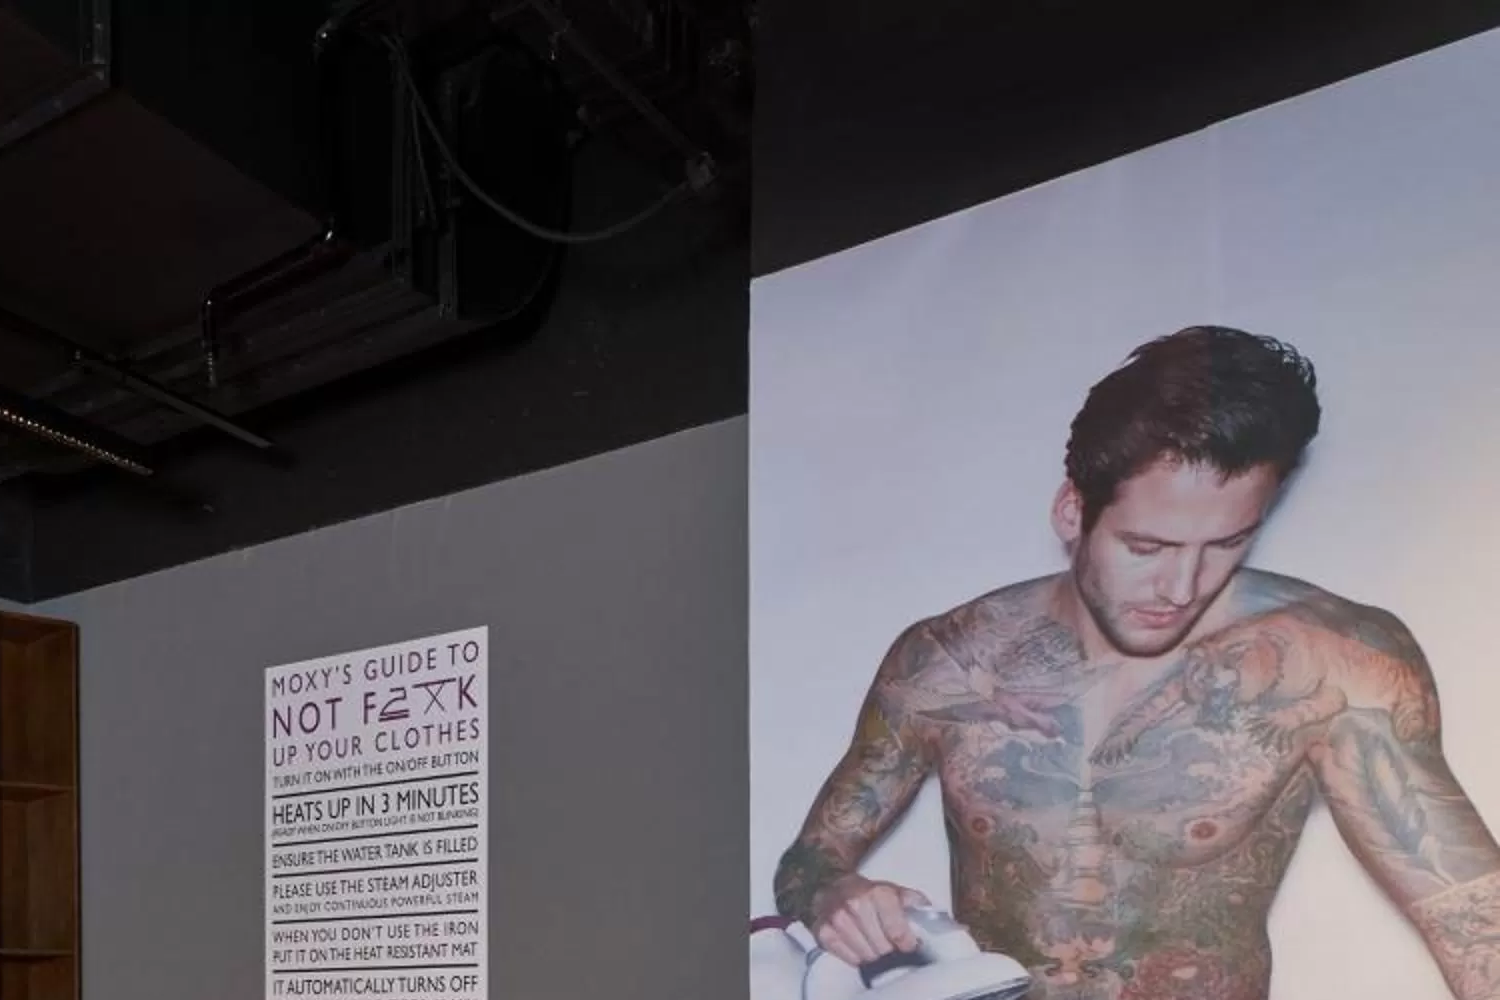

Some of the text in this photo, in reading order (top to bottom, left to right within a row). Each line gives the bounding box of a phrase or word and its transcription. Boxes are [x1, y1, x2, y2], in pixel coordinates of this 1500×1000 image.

[272, 641, 479, 698] MOXY'S GUIDE TO
[273, 697, 343, 739] NOT
[273, 717, 480, 767] UP YOUR CLOTHES
[273, 774, 300, 788] TURN
[314, 770, 331, 782] ON
[333, 766, 360, 781] WITH
[362, 762, 384, 776] THE
[431, 751, 479, 768] BUTTON
[273, 782, 479, 825] HEATS UP IN 3 MINUTES
[273, 836, 478, 868] ENSURE THE WATER TANK IS FILLED
[273, 870, 477, 899] PLEASE USE THE STEAM ADJUSTER
[446, 891, 479, 905] STEAM
[273, 921, 479, 943] WHEN YOU DON'T USE THE IRON
[273, 949, 293, 963] PUT
[309, 948, 328, 963] ON
[330, 947, 351, 961] THE
[353, 946, 383, 960] HEAT
[386, 943, 448, 959] RESISTANT
[451, 942, 478, 957] MAT
[273, 975, 479, 995] IT AUTOMATICALLY TURNS OFF
